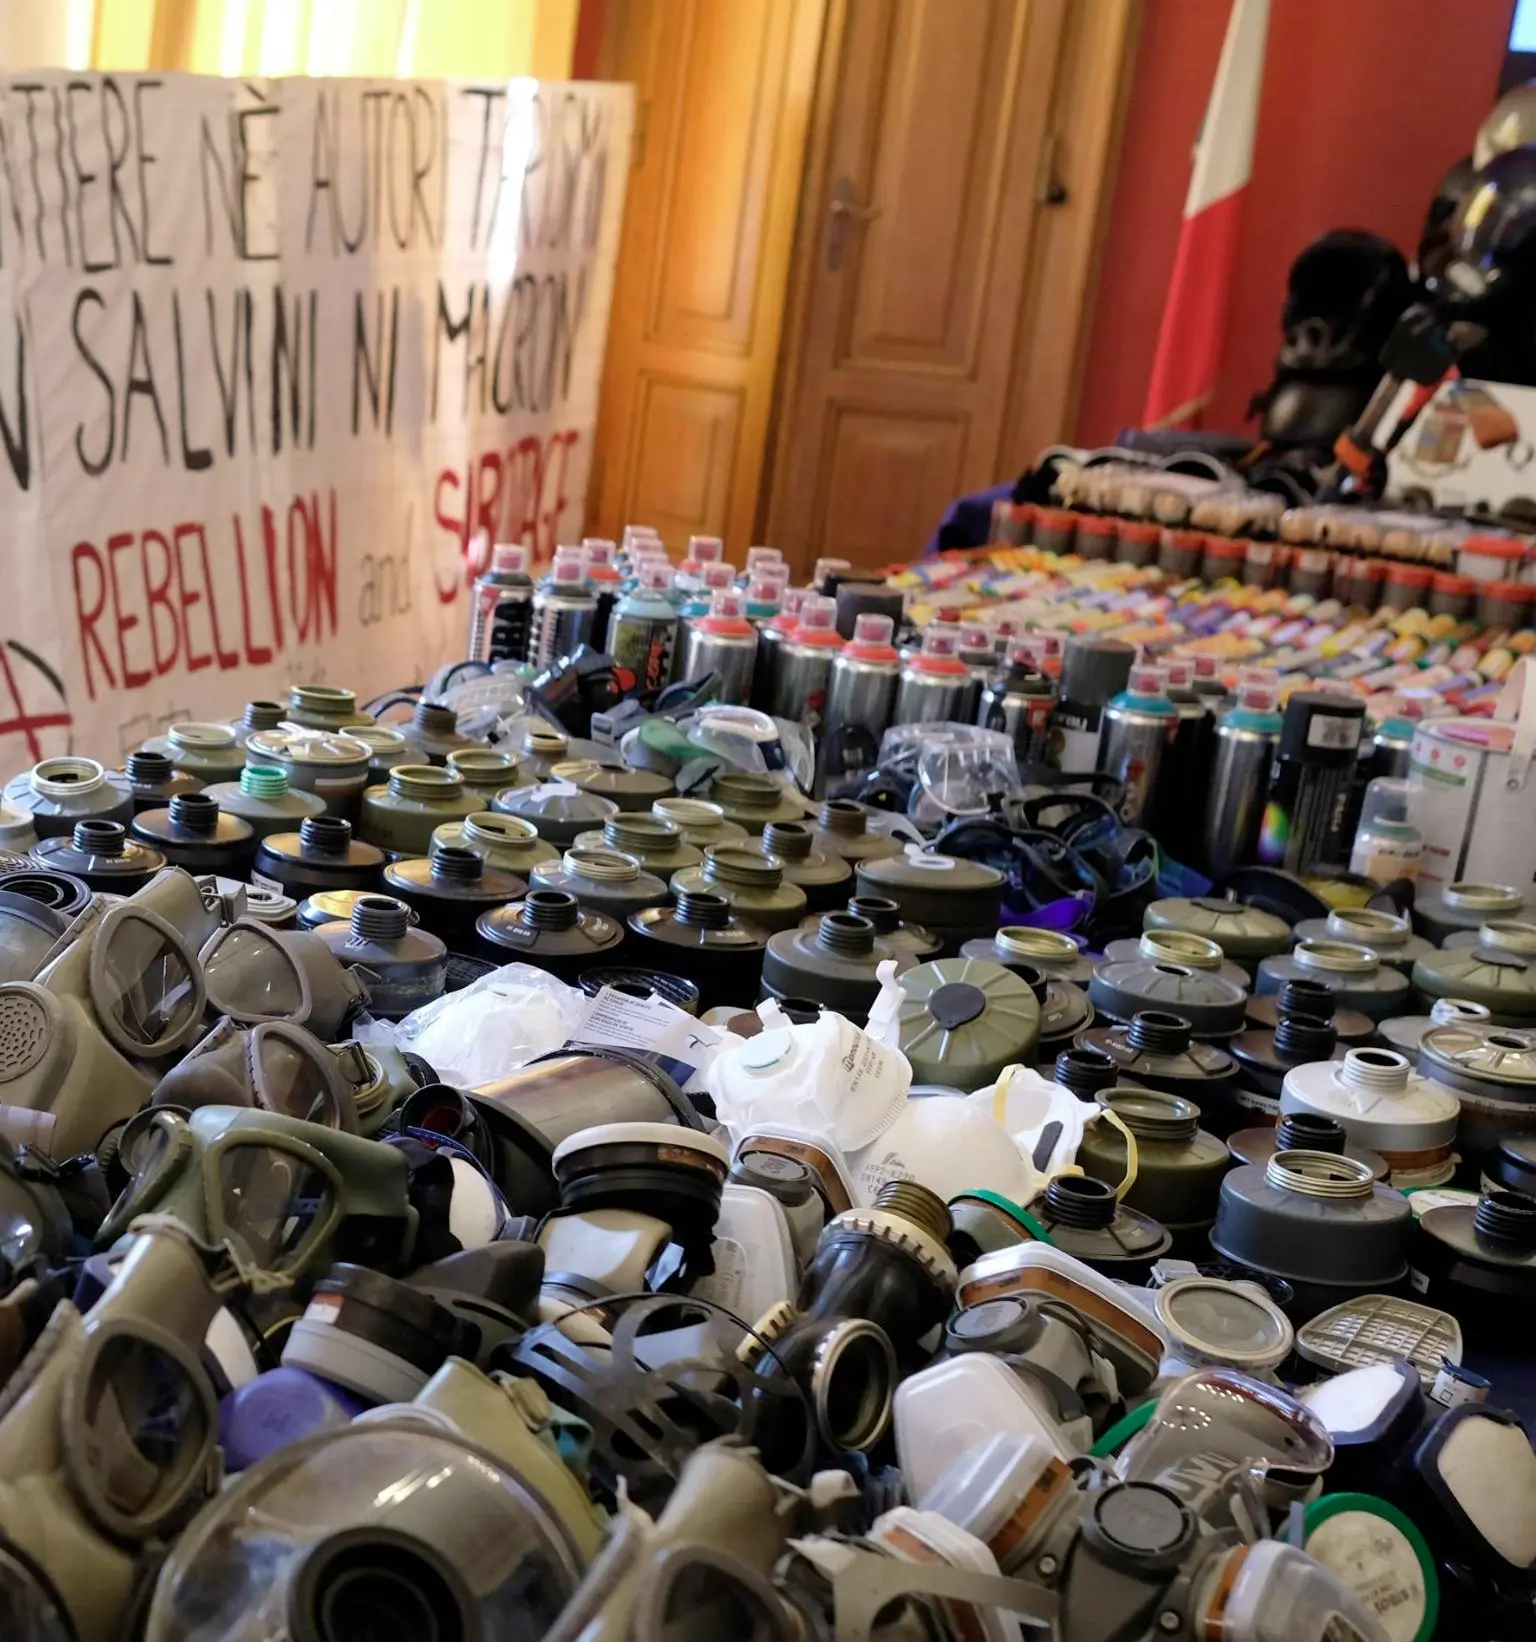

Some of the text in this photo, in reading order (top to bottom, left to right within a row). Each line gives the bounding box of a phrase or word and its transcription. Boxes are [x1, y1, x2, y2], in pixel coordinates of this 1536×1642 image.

[69, 282, 320, 479] SALVINI
[348, 284, 401, 441] NI
[428, 266, 587, 425] MACRON
[72, 490, 339, 699] REBELLION
[358, 506, 414, 629] and
